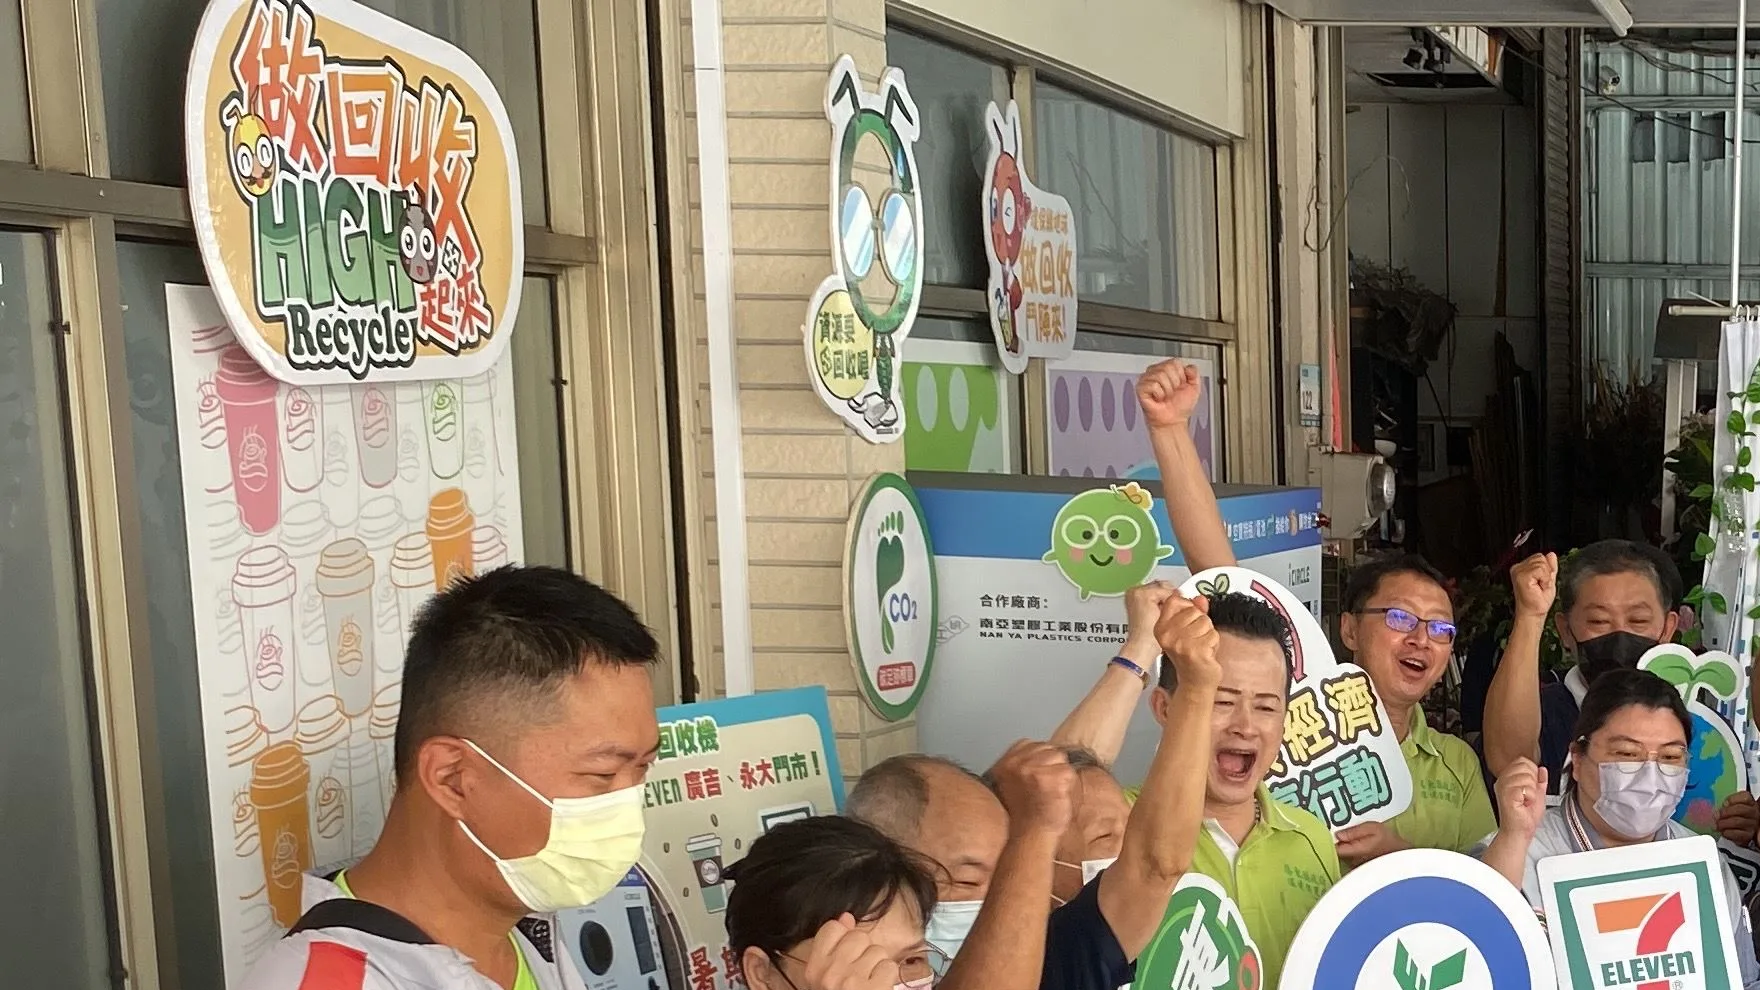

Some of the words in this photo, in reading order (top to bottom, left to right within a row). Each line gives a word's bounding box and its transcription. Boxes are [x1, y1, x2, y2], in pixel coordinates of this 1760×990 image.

[238, 2, 478, 262] 做回收
[255, 178, 418, 312] HIGH
[290, 307, 415, 371] Recycle
[419, 275, 490, 346] 起來
[979, 631, 1003, 639] NAN
[1027, 633, 1082, 642] PLASTICS
[1269, 673, 1380, 773] 經濟
